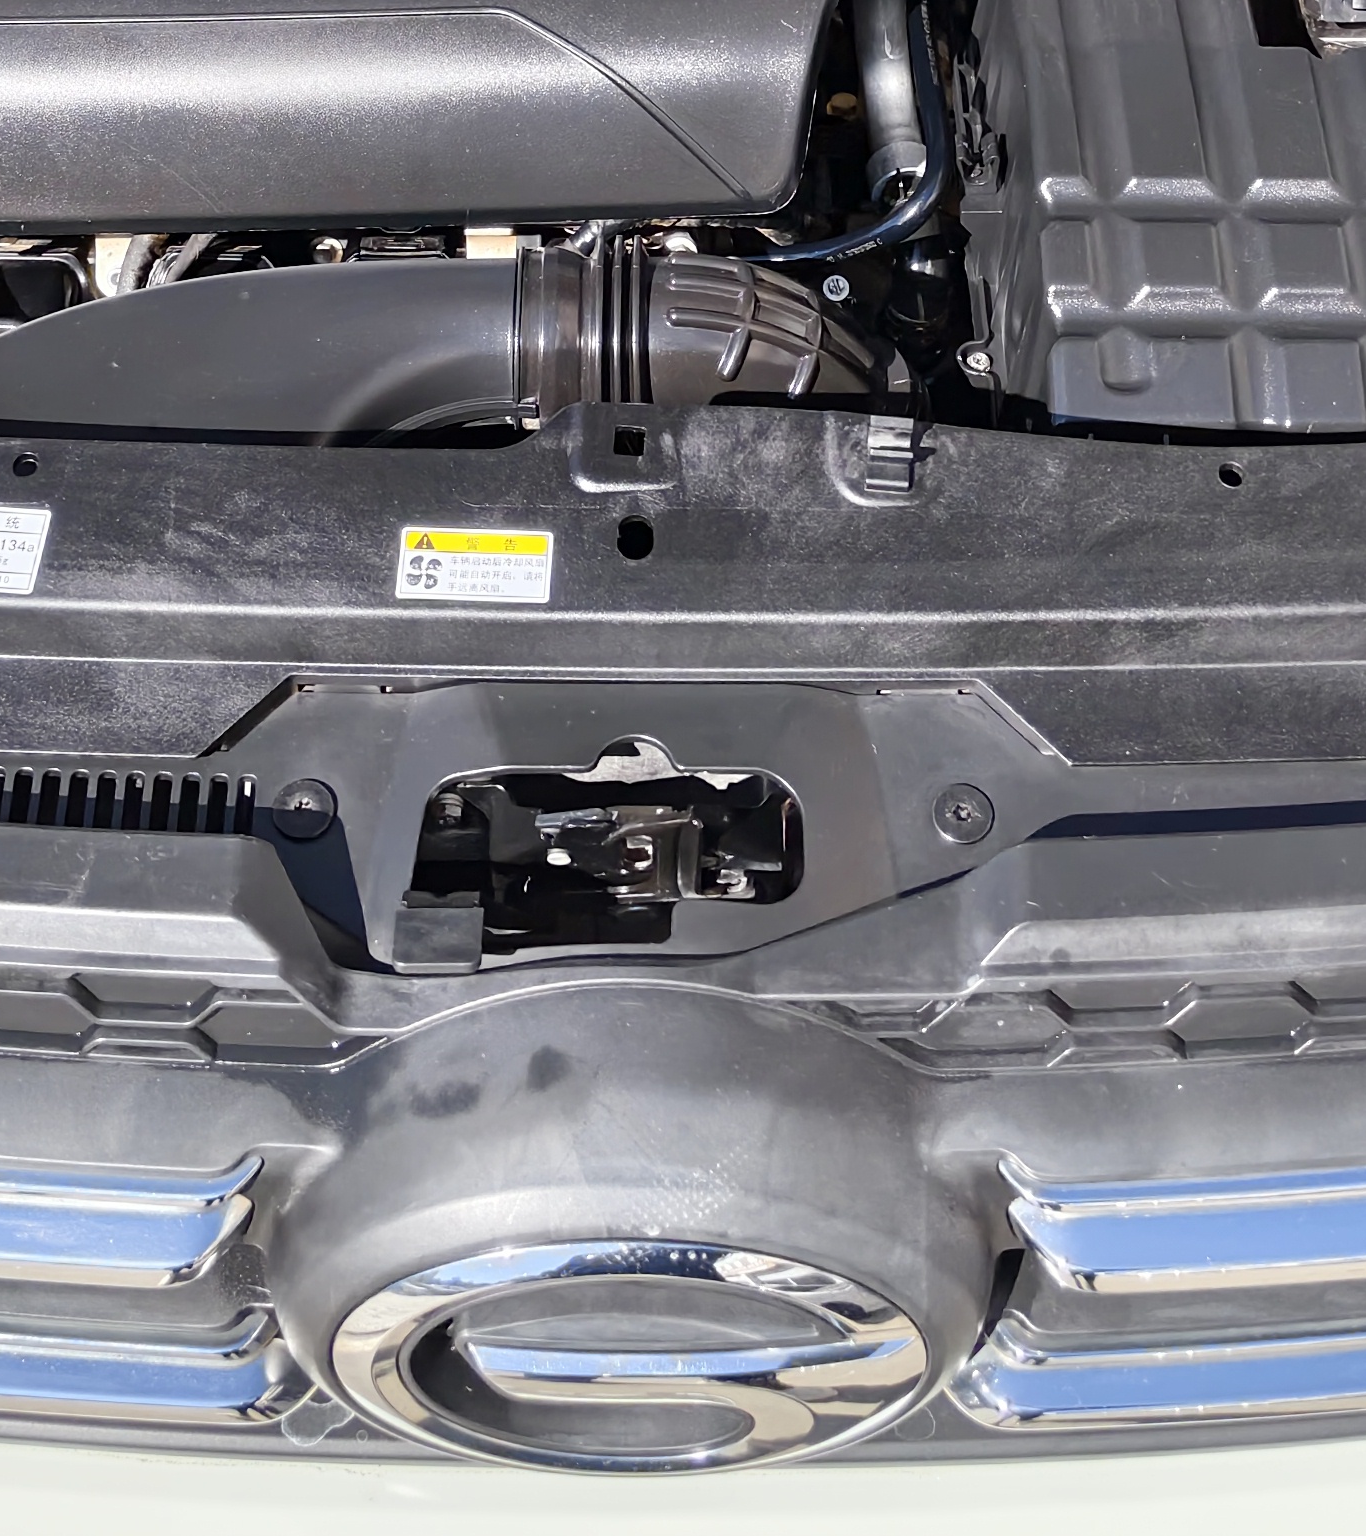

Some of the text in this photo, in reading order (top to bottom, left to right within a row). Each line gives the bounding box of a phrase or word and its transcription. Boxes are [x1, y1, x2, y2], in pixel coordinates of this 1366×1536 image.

[466, 536, 518, 552] 警告
[450, 555, 545, 568] 车辆启动后冷却风扇
